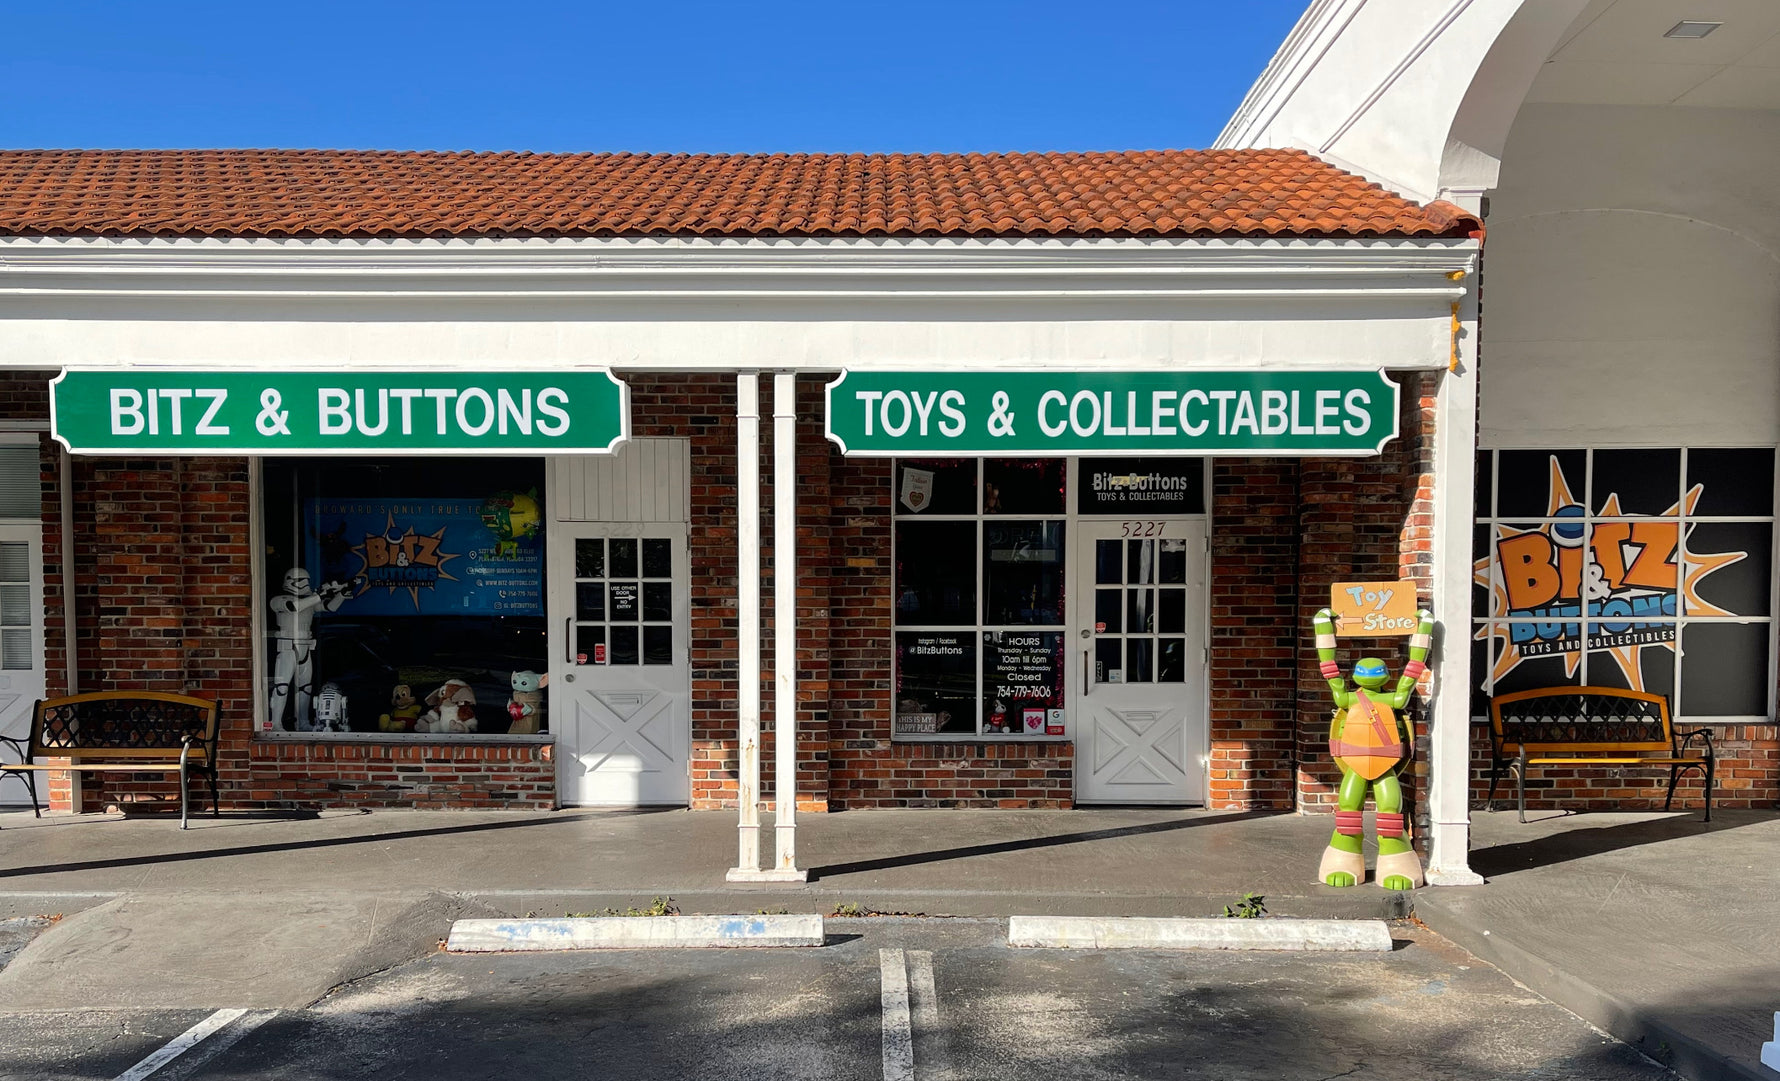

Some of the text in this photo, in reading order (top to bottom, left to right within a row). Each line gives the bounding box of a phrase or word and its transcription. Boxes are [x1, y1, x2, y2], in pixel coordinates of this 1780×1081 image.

[110, 387, 571, 437] BITZ & BUTTONS
[856, 389, 1372, 438] TOYS & COLLECTABLES
[1096, 492, 1184, 501] TOYS & COLLECTABLES
[393, 505, 423, 514] ONLY
[431, 505, 460, 514] TRUE
[1121, 521, 1167, 537] 5227
[1345, 586, 1394, 611] Toy
[1363, 612, 1415, 631] Store
[1509, 594, 1680, 643] BUTTONS
[1008, 638, 1040, 646] HOURS
[1522, 630, 1676, 655] TOYS AND COLLECTIBLES
[1031, 656, 1047, 664] 6pm
[1007, 673, 1041, 681] Closed
[997, 686, 1051, 698] 754-779-7606
[897, 715, 913, 723] THIS
[913, 715, 921, 723] IS
[896, 724, 936, 732] HAPPY PLACE
